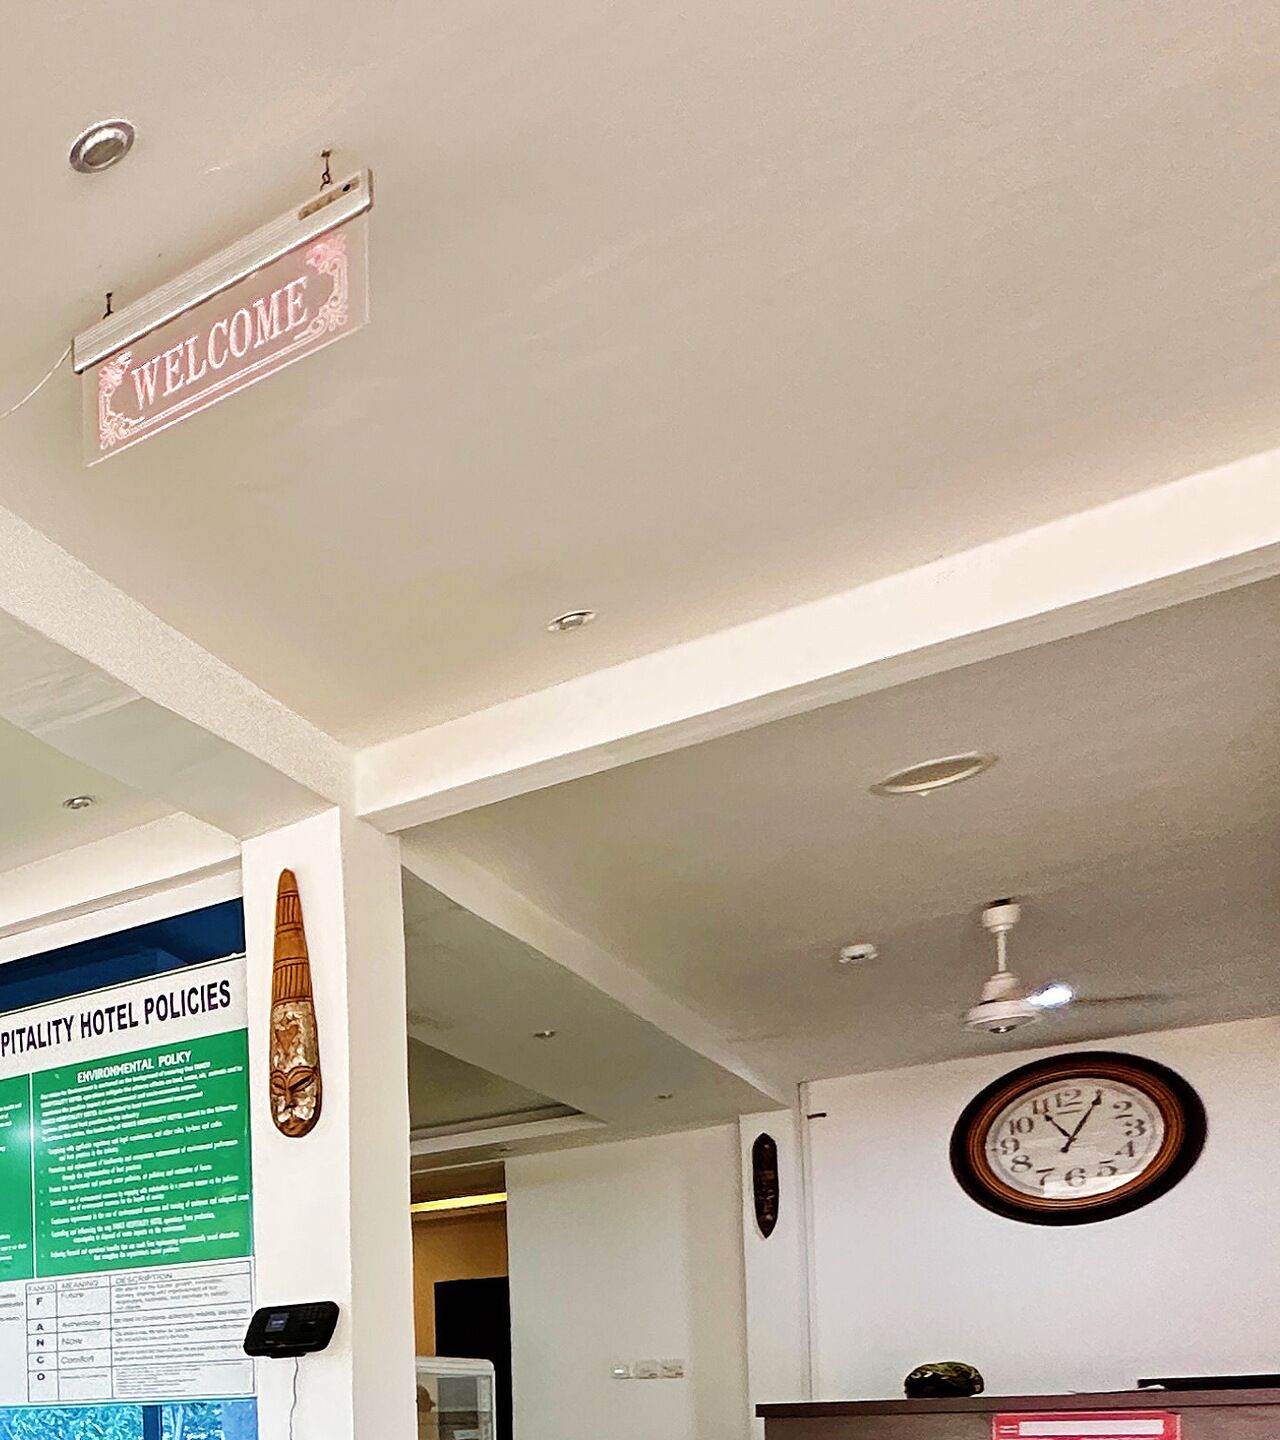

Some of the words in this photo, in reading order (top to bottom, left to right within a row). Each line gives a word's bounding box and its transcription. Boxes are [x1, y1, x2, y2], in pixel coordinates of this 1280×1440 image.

[129, 275, 310, 412] WELCOME
[80, 1002, 139, 1039] HOTEL
[144, 979, 232, 1025] POLICIES
[76, 1058, 154, 1084] ENVIRONMENTAL
[158, 1050, 192, 1068] POLICY
[1031, 1097, 1050, 1115] 11
[1056, 1088, 1082, 1108] 12
[1112, 1100, 1133, 1120] 2
[1008, 1116, 1034, 1136] 10
[1125, 1119, 1148, 1138] 3
[1000, 1137, 1020, 1155] 9
[1115, 1140, 1135, 1158] 4
[1010, 1154, 1033, 1173] 8
[1096, 1159, 1119, 1177] 5
[1036, 1167, 1055, 1186] 7
[1065, 1167, 1086, 1188] 6
[61, 1280, 99, 1290] MEANING
[115, 1272, 173, 1285] DESCRIPTION
[36, 1297, 43, 1306] F
[36, 1323, 44, 1331] A
[36, 1338, 45, 1347] N
[36, 1355, 44, 1364] C
